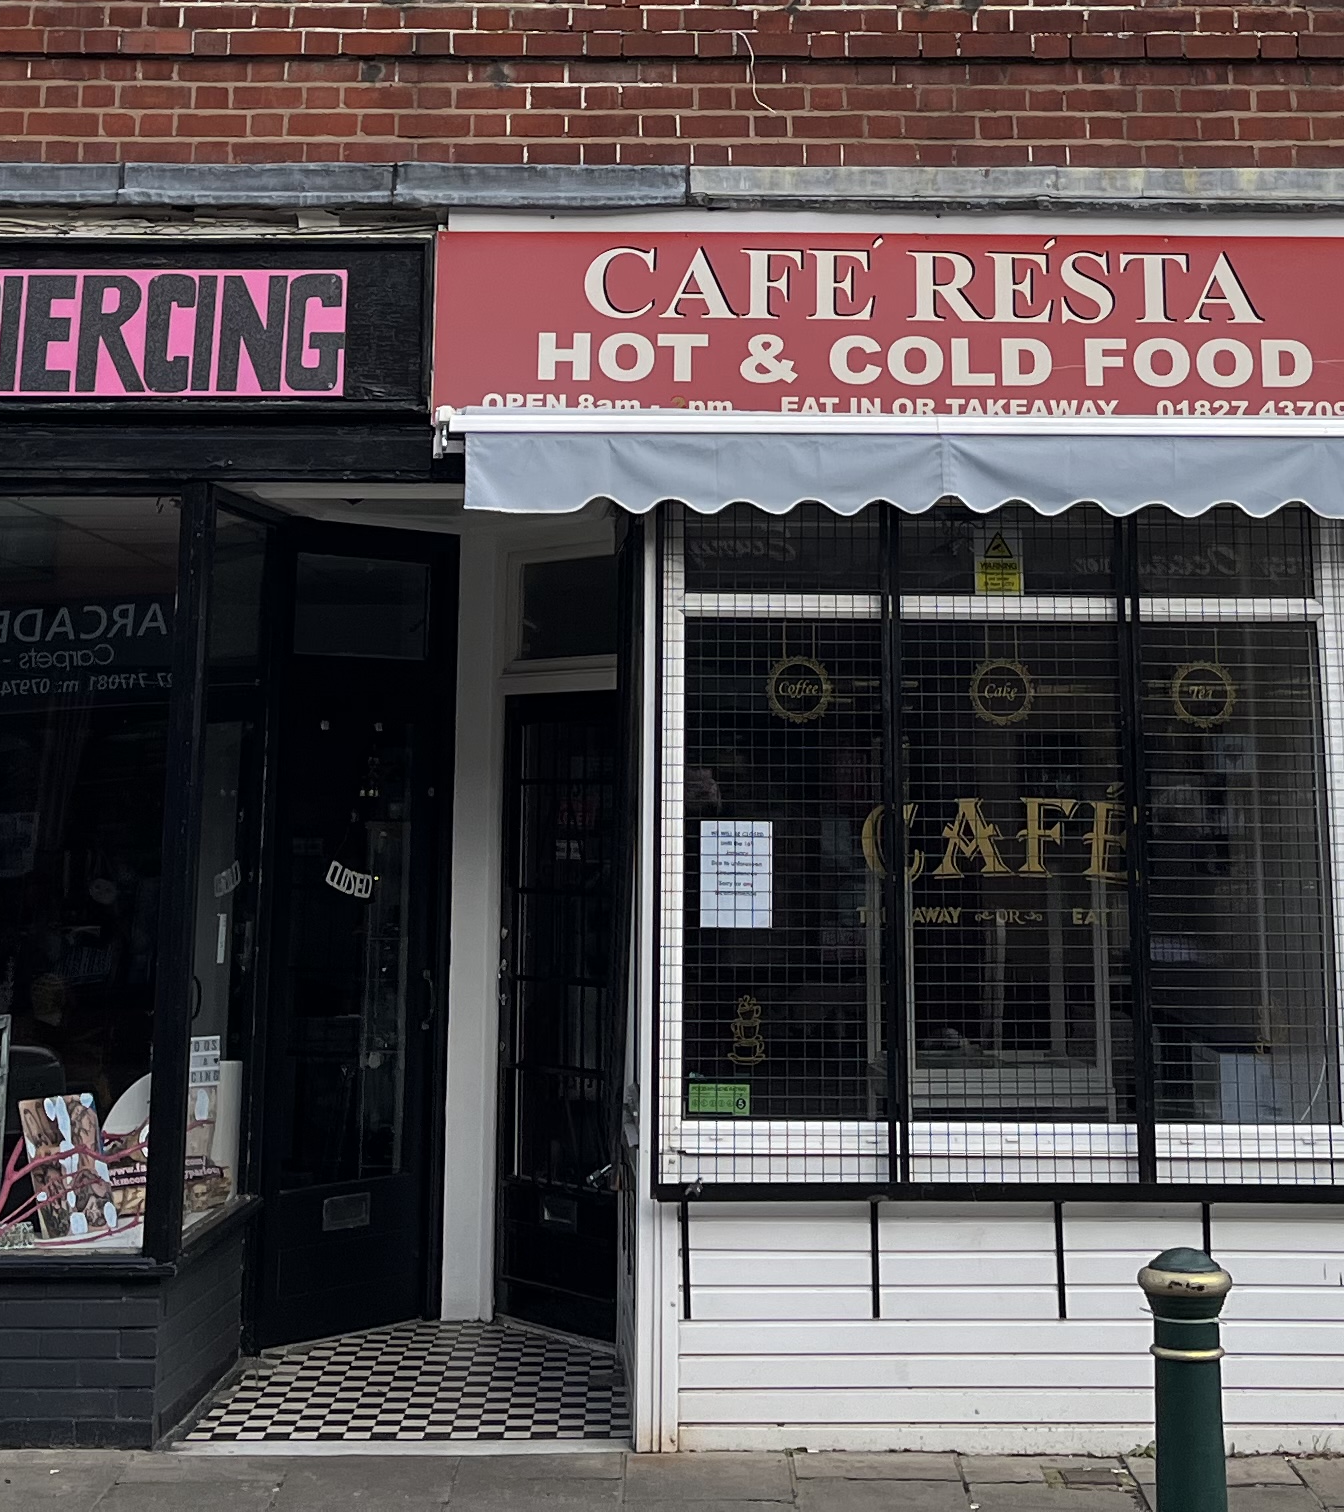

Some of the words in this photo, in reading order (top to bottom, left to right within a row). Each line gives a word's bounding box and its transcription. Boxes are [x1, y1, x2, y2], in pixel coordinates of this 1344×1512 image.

[537, 331, 709, 384] HOT
[739, 332, 799, 385] &
[829, 335, 1054, 388] COLD
[1085, 336, 1315, 389] FOOD
[482, 392, 567, 409] OPEN
[781, 396, 840, 415] EAT
[849, 397, 881, 416] IN
[892, 397, 935, 416] OR
[946, 398, 1119, 417] TAKEAWAY
[1156, 399, 1249, 417] 01827
[778, 679, 819, 699] Coffee
[984, 682, 1018, 701] Cake
[325, 859, 373, 899] CLOSED
